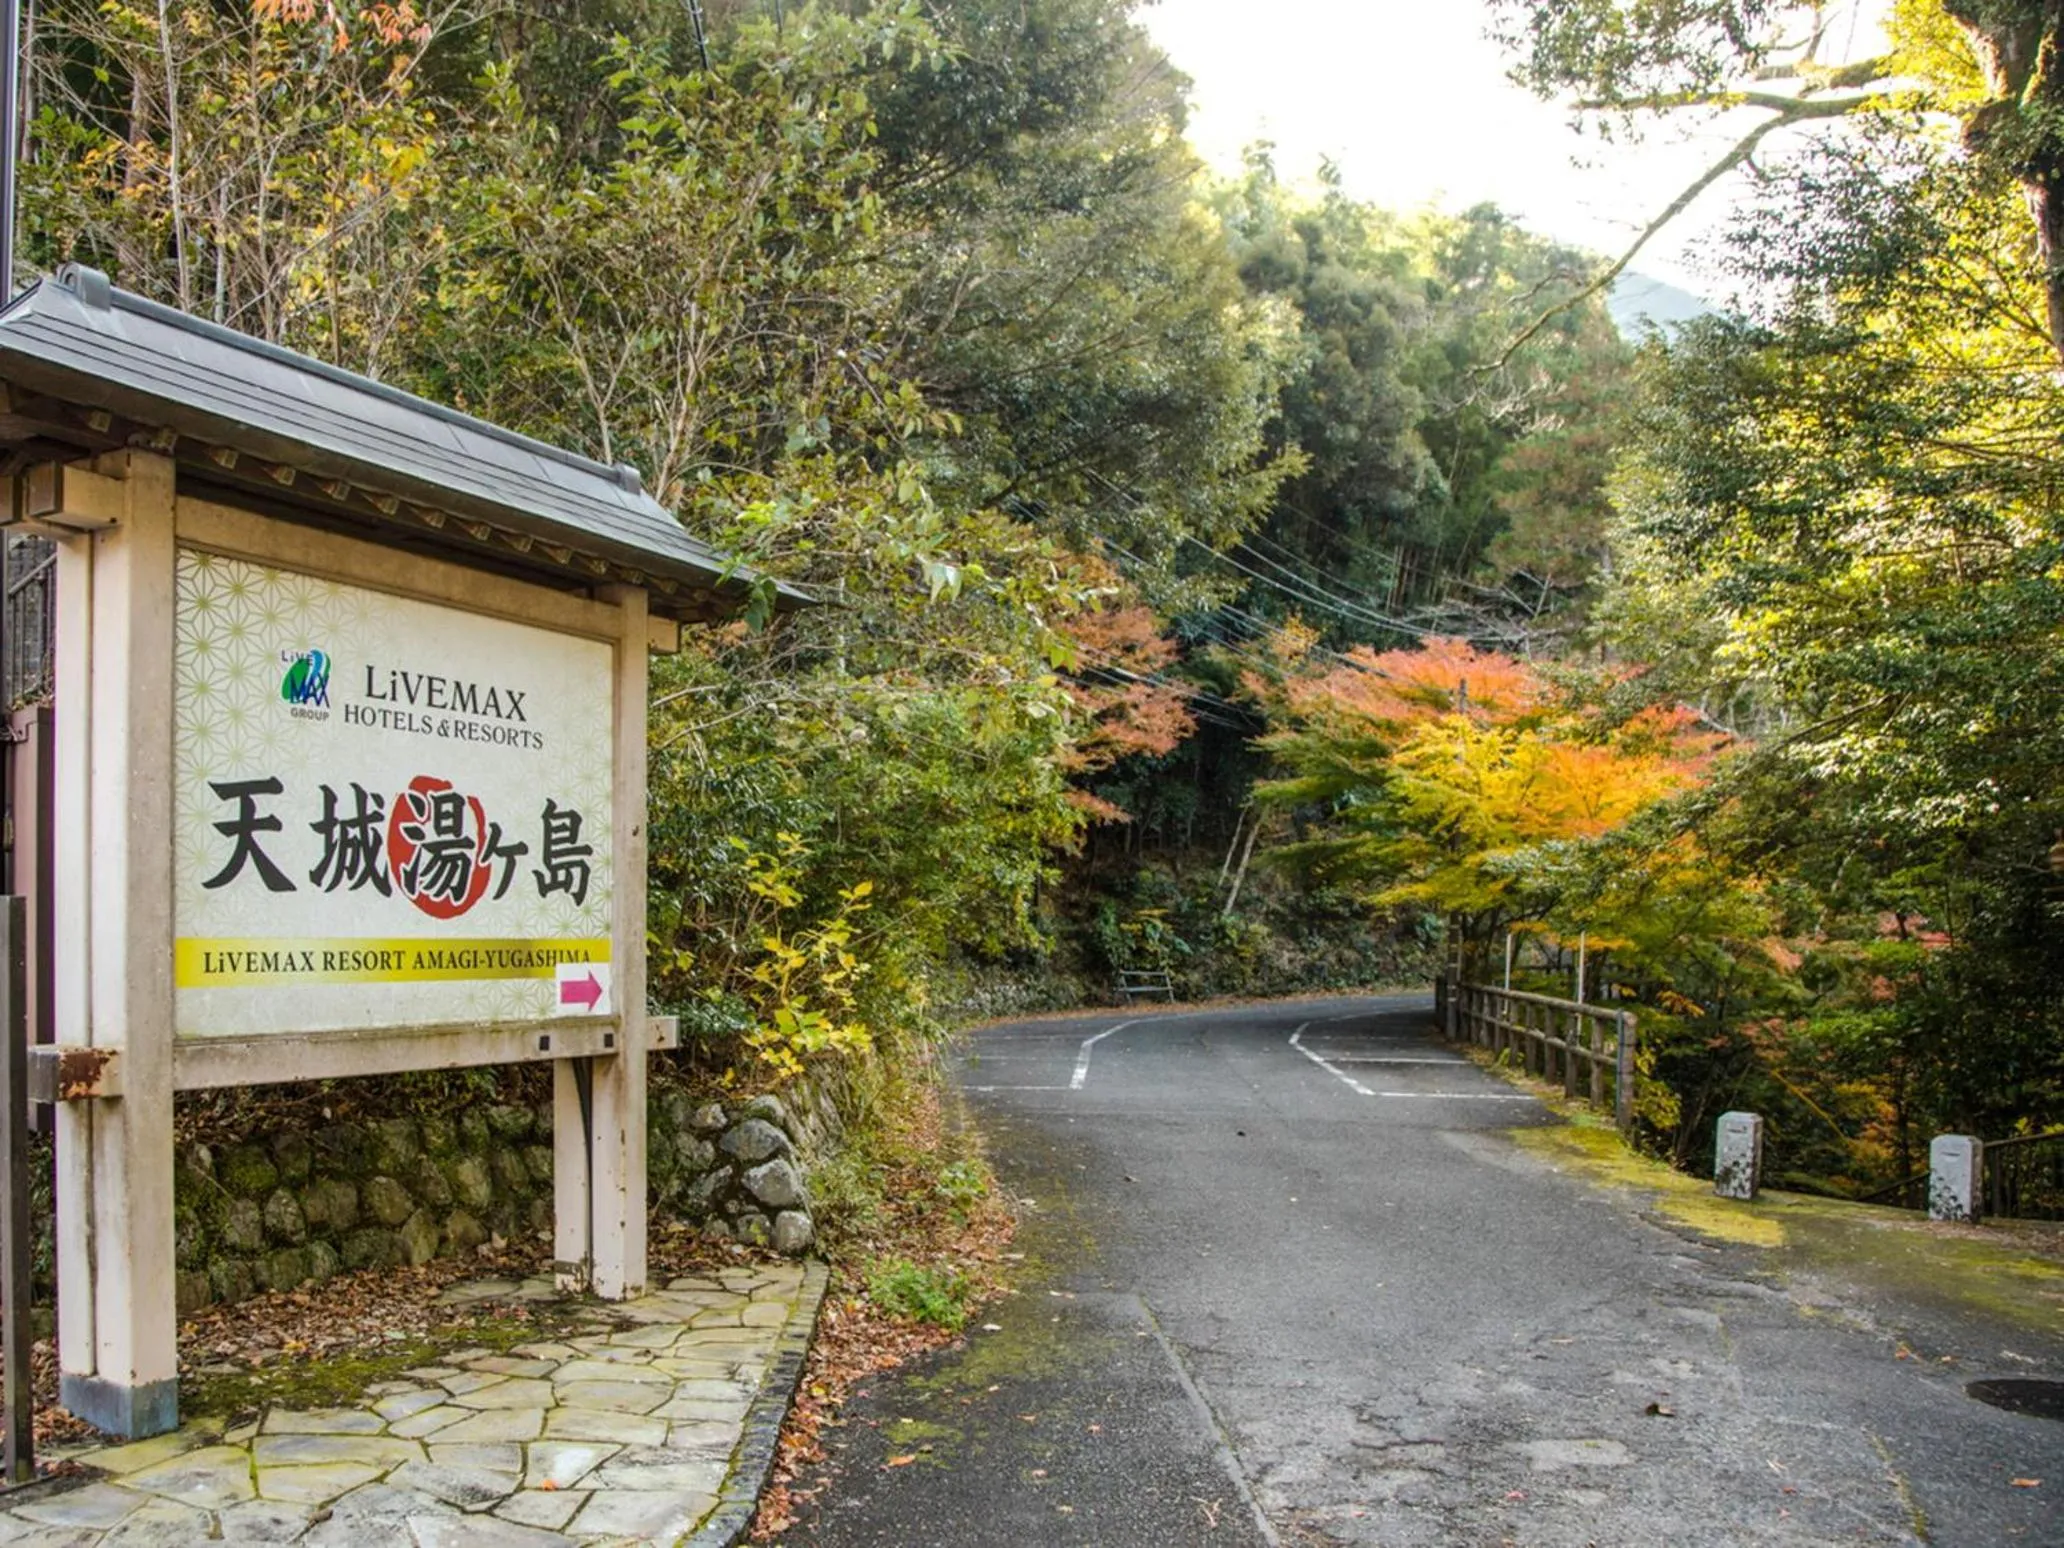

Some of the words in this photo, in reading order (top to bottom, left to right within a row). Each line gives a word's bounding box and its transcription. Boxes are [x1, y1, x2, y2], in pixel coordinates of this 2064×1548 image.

[366, 664, 527, 722] LiVEMAX
[290, 707, 330, 722] GROUP
[203, 950, 315, 974] LiVEMAX
[322, 950, 406, 972] RESORT
[412, 949, 591, 970] AMAGI-YUGASHIMA
